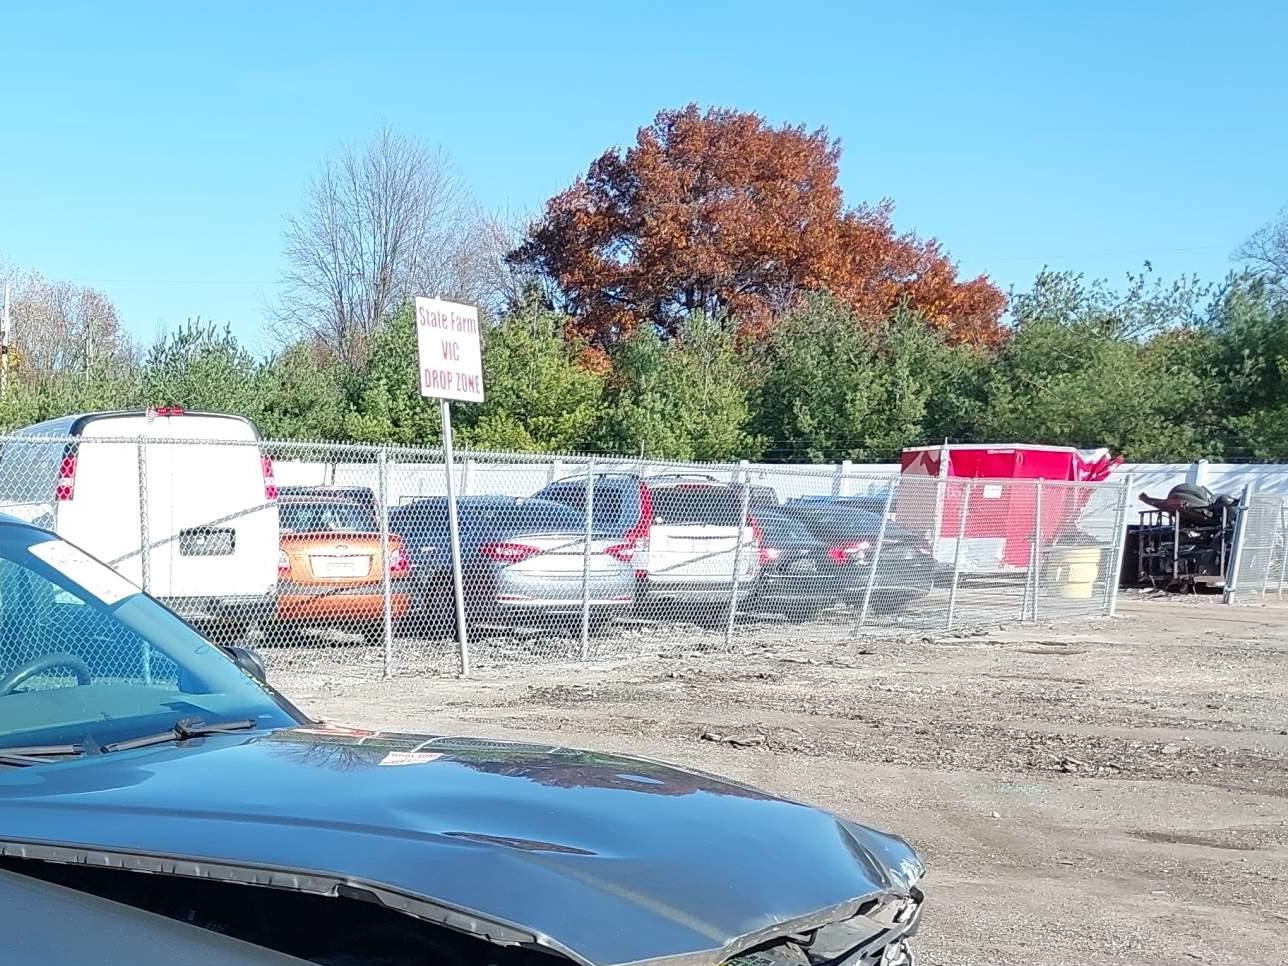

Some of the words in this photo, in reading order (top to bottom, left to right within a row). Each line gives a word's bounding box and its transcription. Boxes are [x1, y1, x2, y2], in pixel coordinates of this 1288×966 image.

[418, 306, 448, 330] State
[451, 311, 477, 334] Farm
[441, 339, 460, 362] VIC
[424, 368, 453, 390] DROP
[455, 372, 481, 394] ZONE
